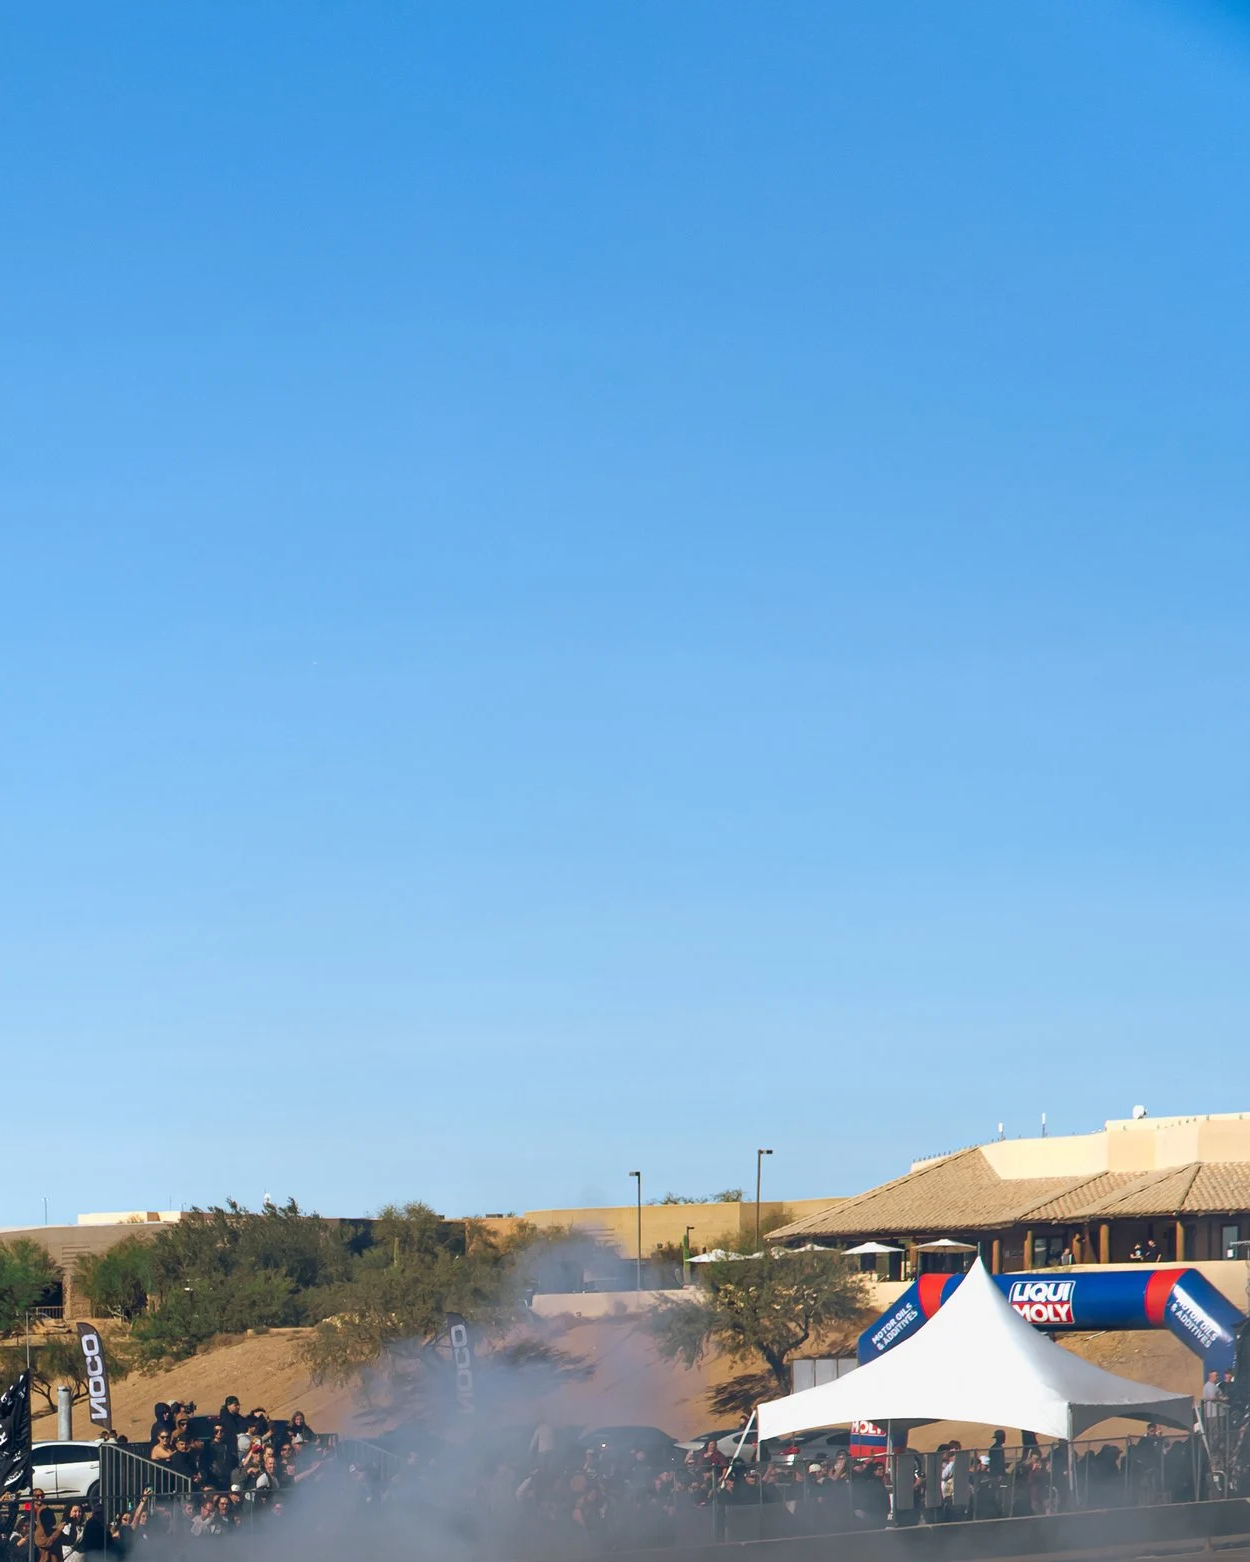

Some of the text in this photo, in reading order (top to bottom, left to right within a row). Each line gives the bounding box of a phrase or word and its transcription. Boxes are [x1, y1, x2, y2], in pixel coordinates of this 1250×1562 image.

[1012, 1283, 1071, 1302] LIQUI
[872, 1302, 913, 1345] MOTOR OILS
[882, 1310, 919, 1346] ADDITIVES
[1012, 1303, 1070, 1322] MOLY
[1175, 1310, 1212, 1348] ADDITIVES
